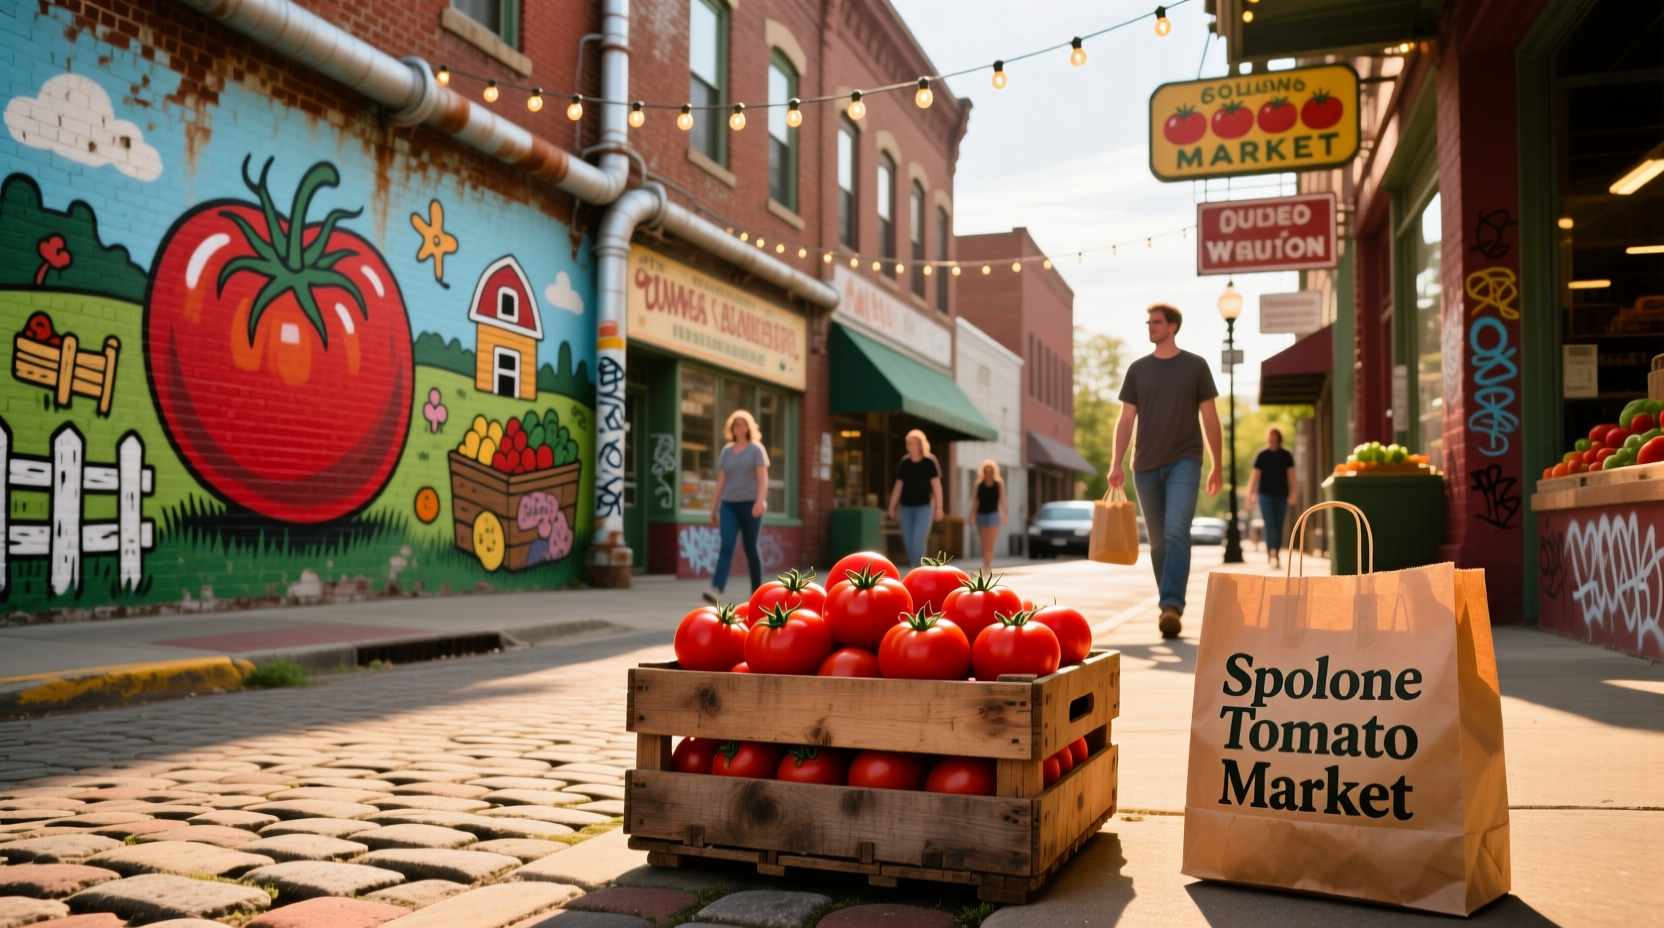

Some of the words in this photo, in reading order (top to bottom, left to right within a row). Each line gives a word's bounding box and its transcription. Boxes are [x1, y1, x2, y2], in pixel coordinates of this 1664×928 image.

[1176, 132, 1339, 169] MARKET
[1223, 653, 1422, 707] Spolone
[1220, 706, 1418, 760] Tomato
[1218, 759, 1413, 821] Market
